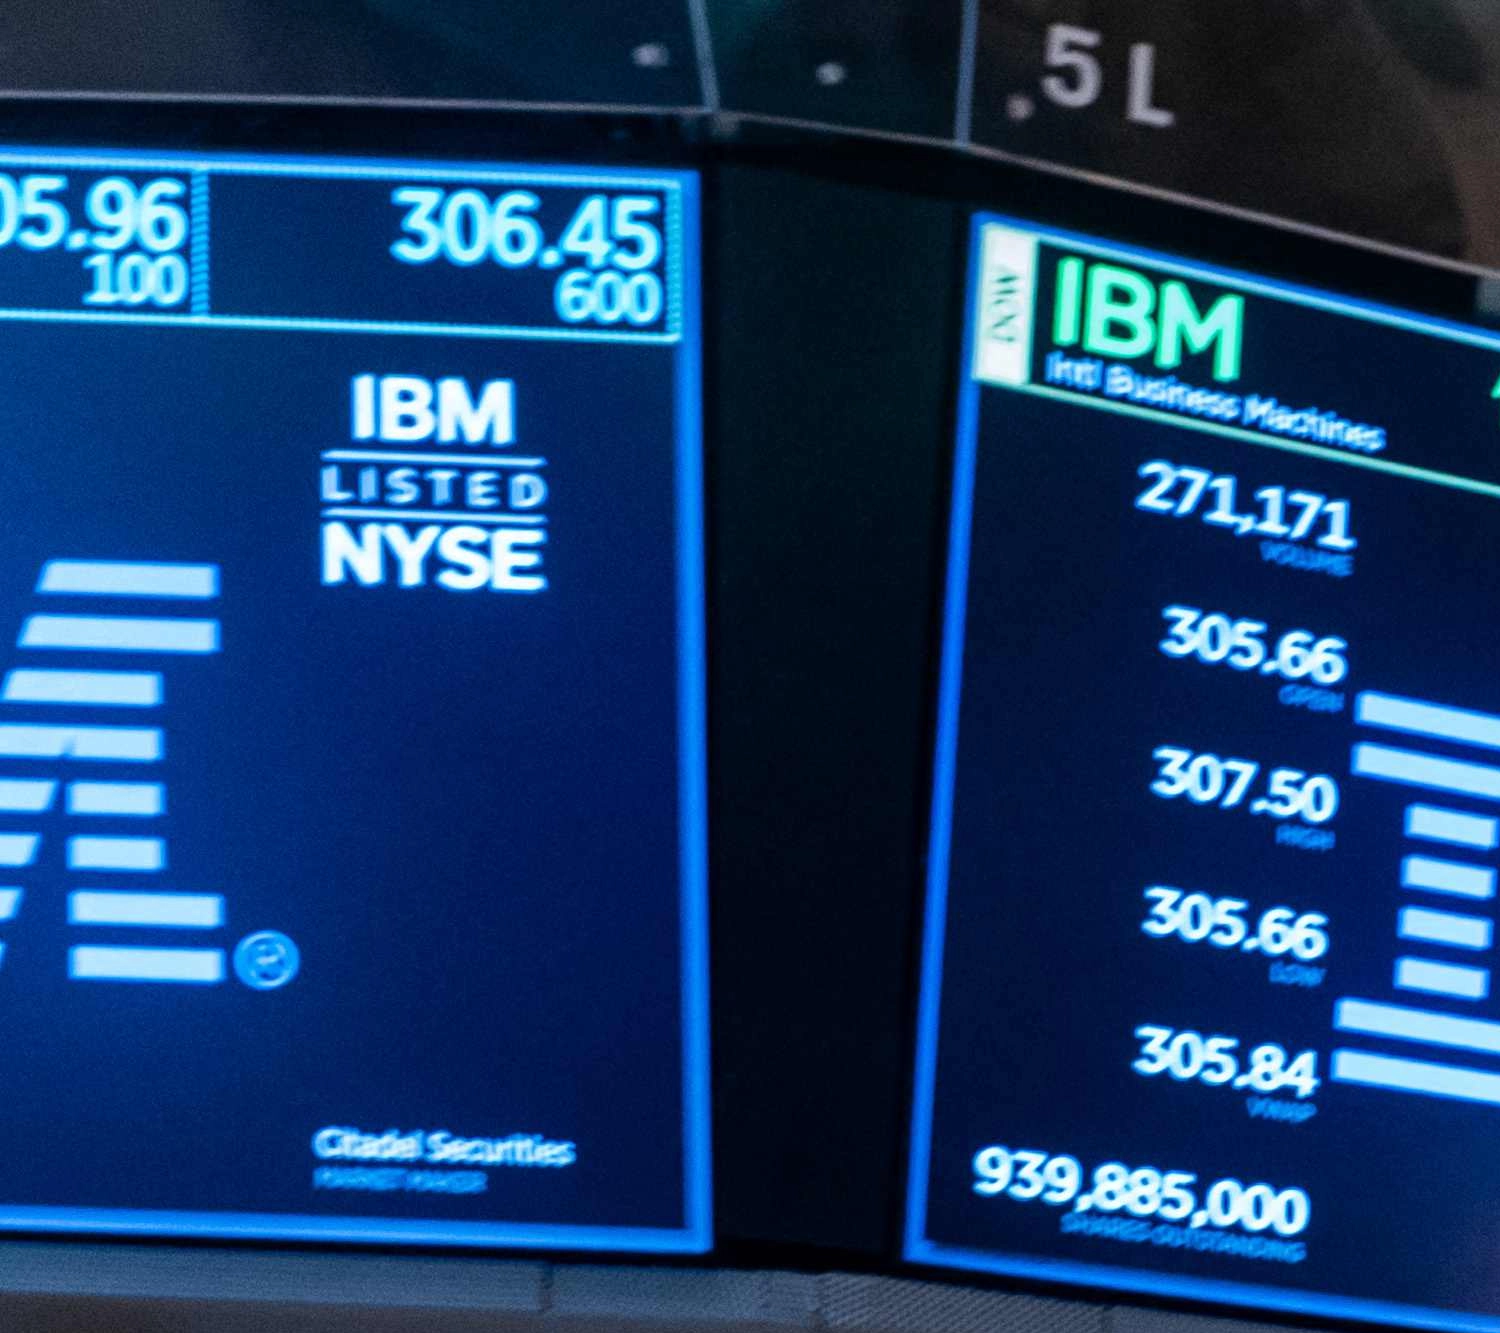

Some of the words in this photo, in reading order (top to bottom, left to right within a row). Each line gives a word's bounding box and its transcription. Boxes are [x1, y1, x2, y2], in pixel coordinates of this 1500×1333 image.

[1040, 24, 1103, 109] 5
[1125, 43, 1176, 127] L
[390, 188, 661, 268] 306.45
[83, 255, 188, 306] 100
[554, 270, 662, 323] 600
[1052, 256, 1244, 382] IBM
[351, 374, 516, 446] IBM
[321, 466, 549, 509] LISTED
[1134, 458, 1358, 550] 271,171
[321, 524, 549, 592] NYSE
[1159, 605, 1348, 685] 305.66
[1150, 746, 1340, 824] 307.50
[1140, 885, 1330, 961] 305.66
[1130, 1023, 1320, 1100] 305.84
[312, 1125, 423, 1161] Citadel
[424, 1130, 577, 1167] Securities
[971, 1143, 1312, 1237] 939,885,000
